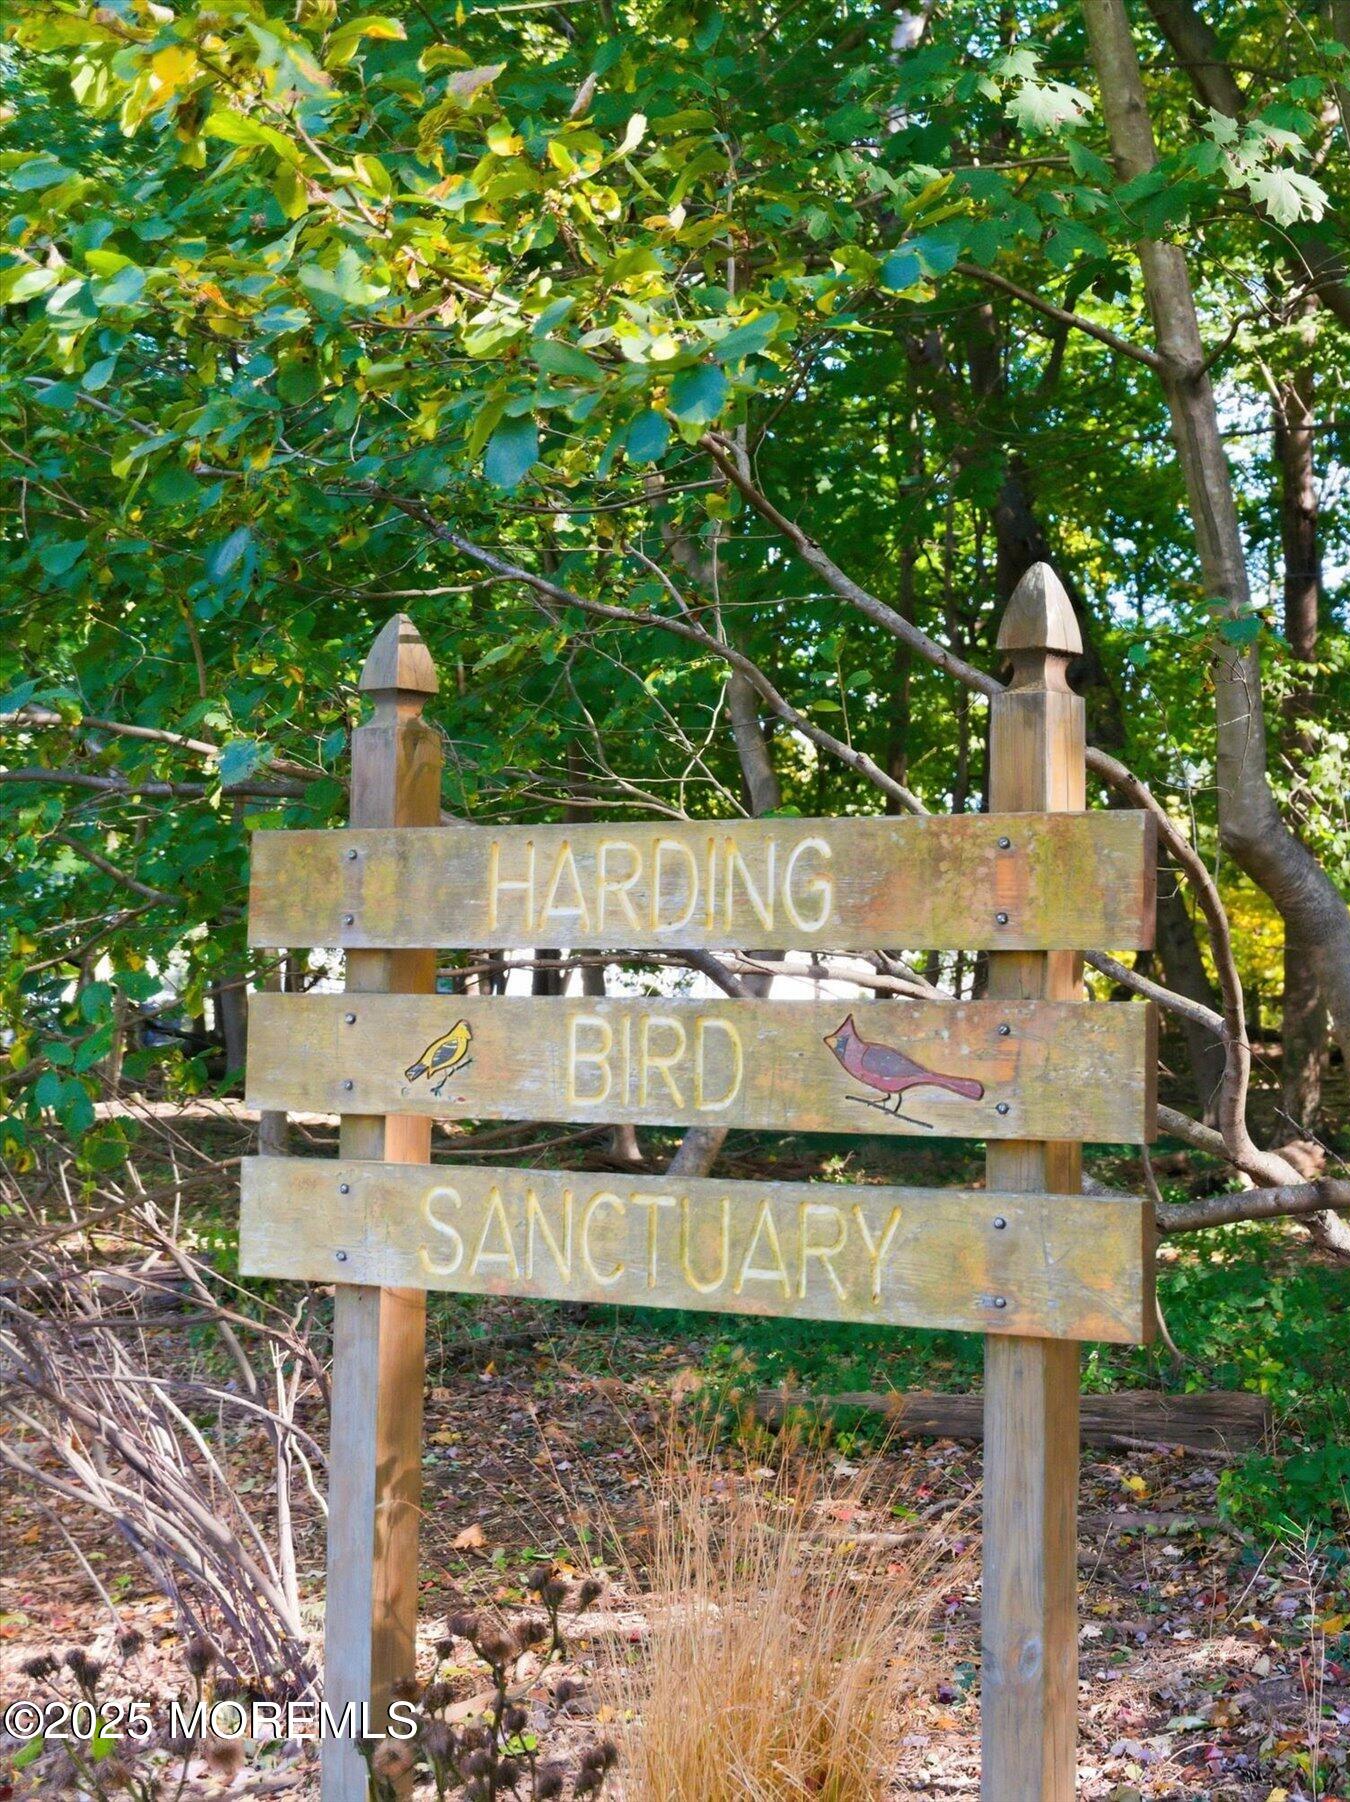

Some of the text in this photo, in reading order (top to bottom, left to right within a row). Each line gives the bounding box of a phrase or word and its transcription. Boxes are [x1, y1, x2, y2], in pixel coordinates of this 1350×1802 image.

[487, 836, 834, 933] HARDING
[565, 1012, 744, 1111] BIRD
[418, 1186, 901, 1304] SANCTUARY
